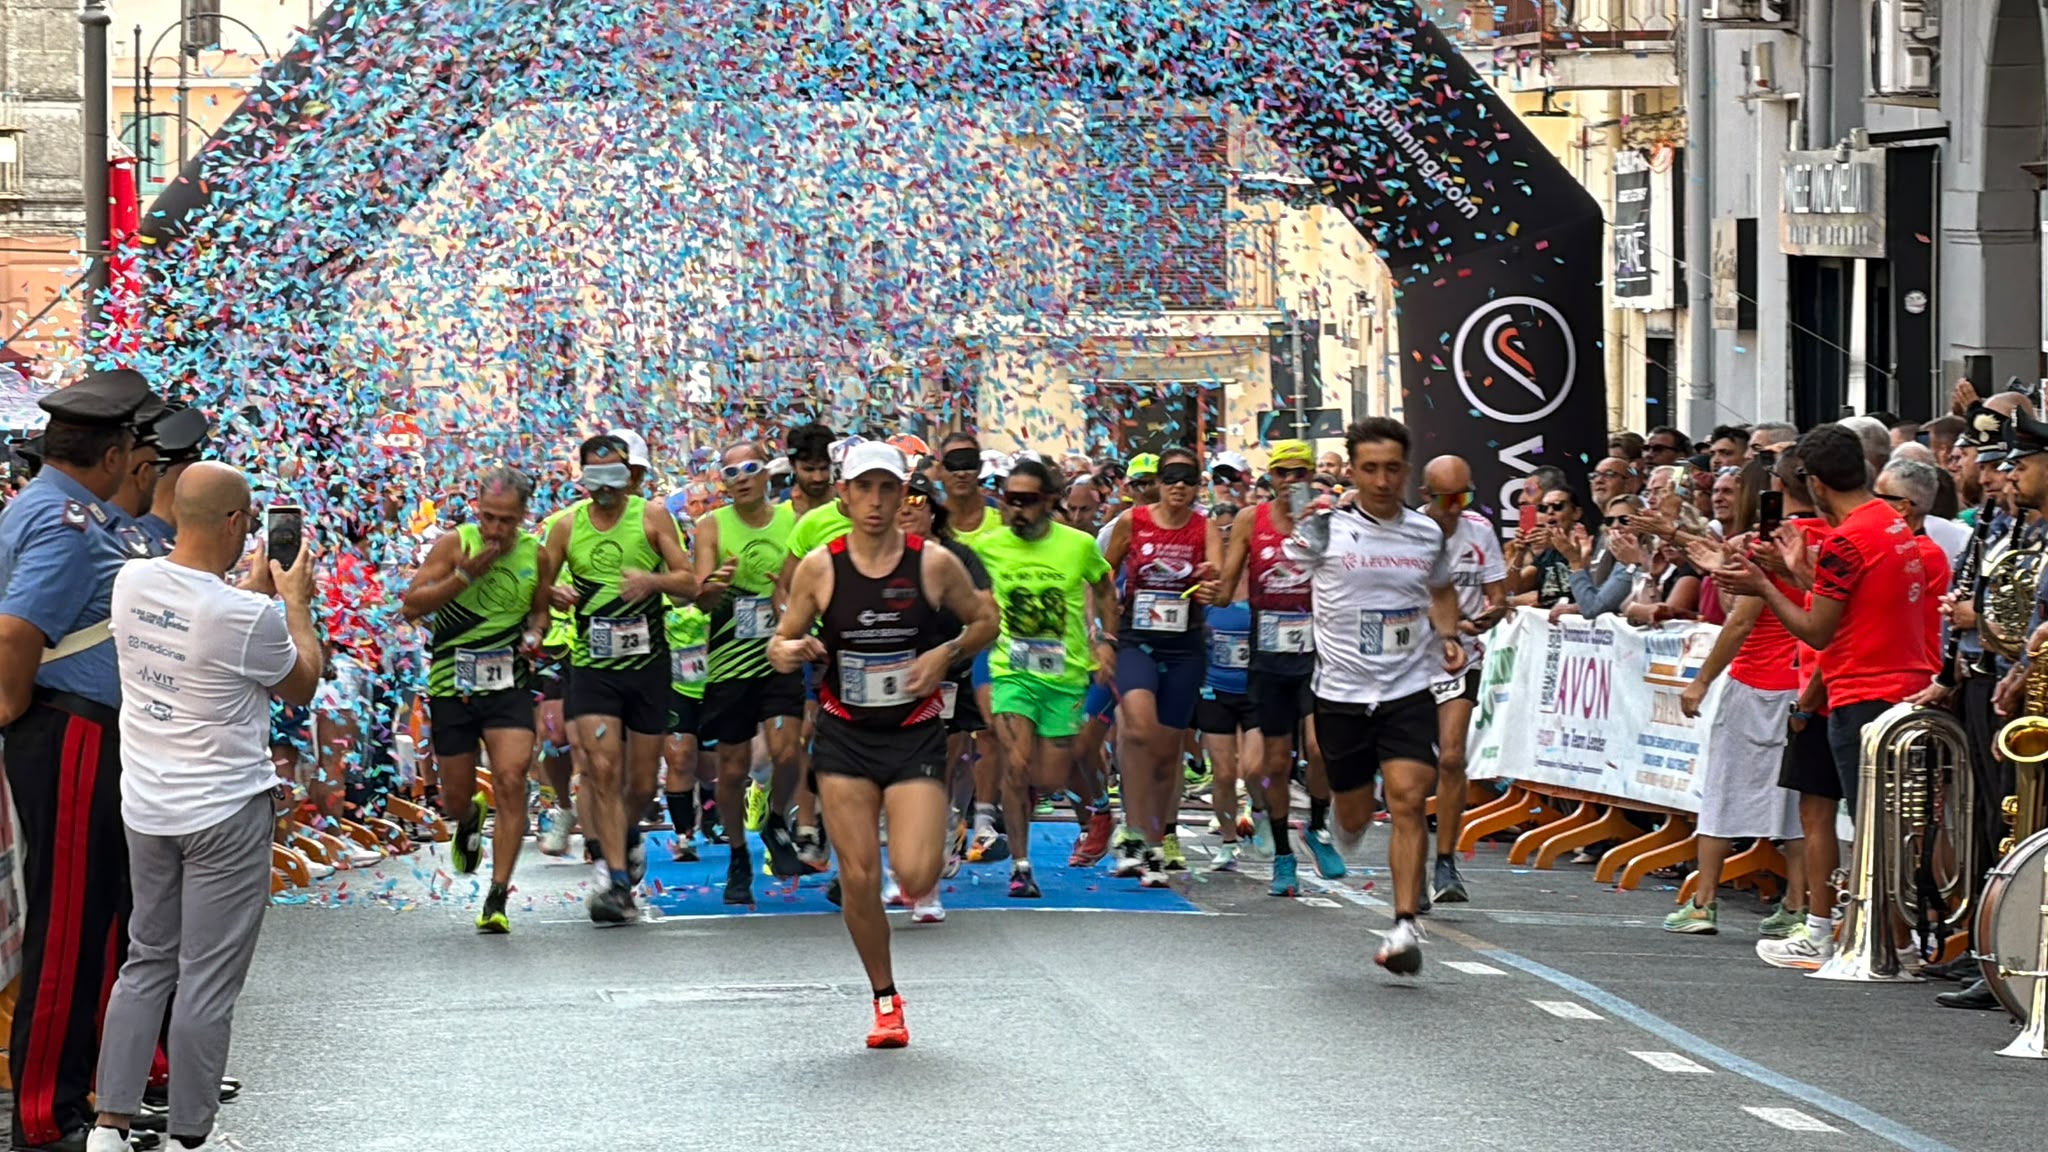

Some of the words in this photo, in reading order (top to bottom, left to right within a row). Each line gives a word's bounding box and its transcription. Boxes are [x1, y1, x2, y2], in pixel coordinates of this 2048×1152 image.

[621, 633, 640, 649] 23
[1395, 626, 1411, 646] 10
[486, 664, 503, 682] 21
[1548, 655, 1613, 721] AVON
